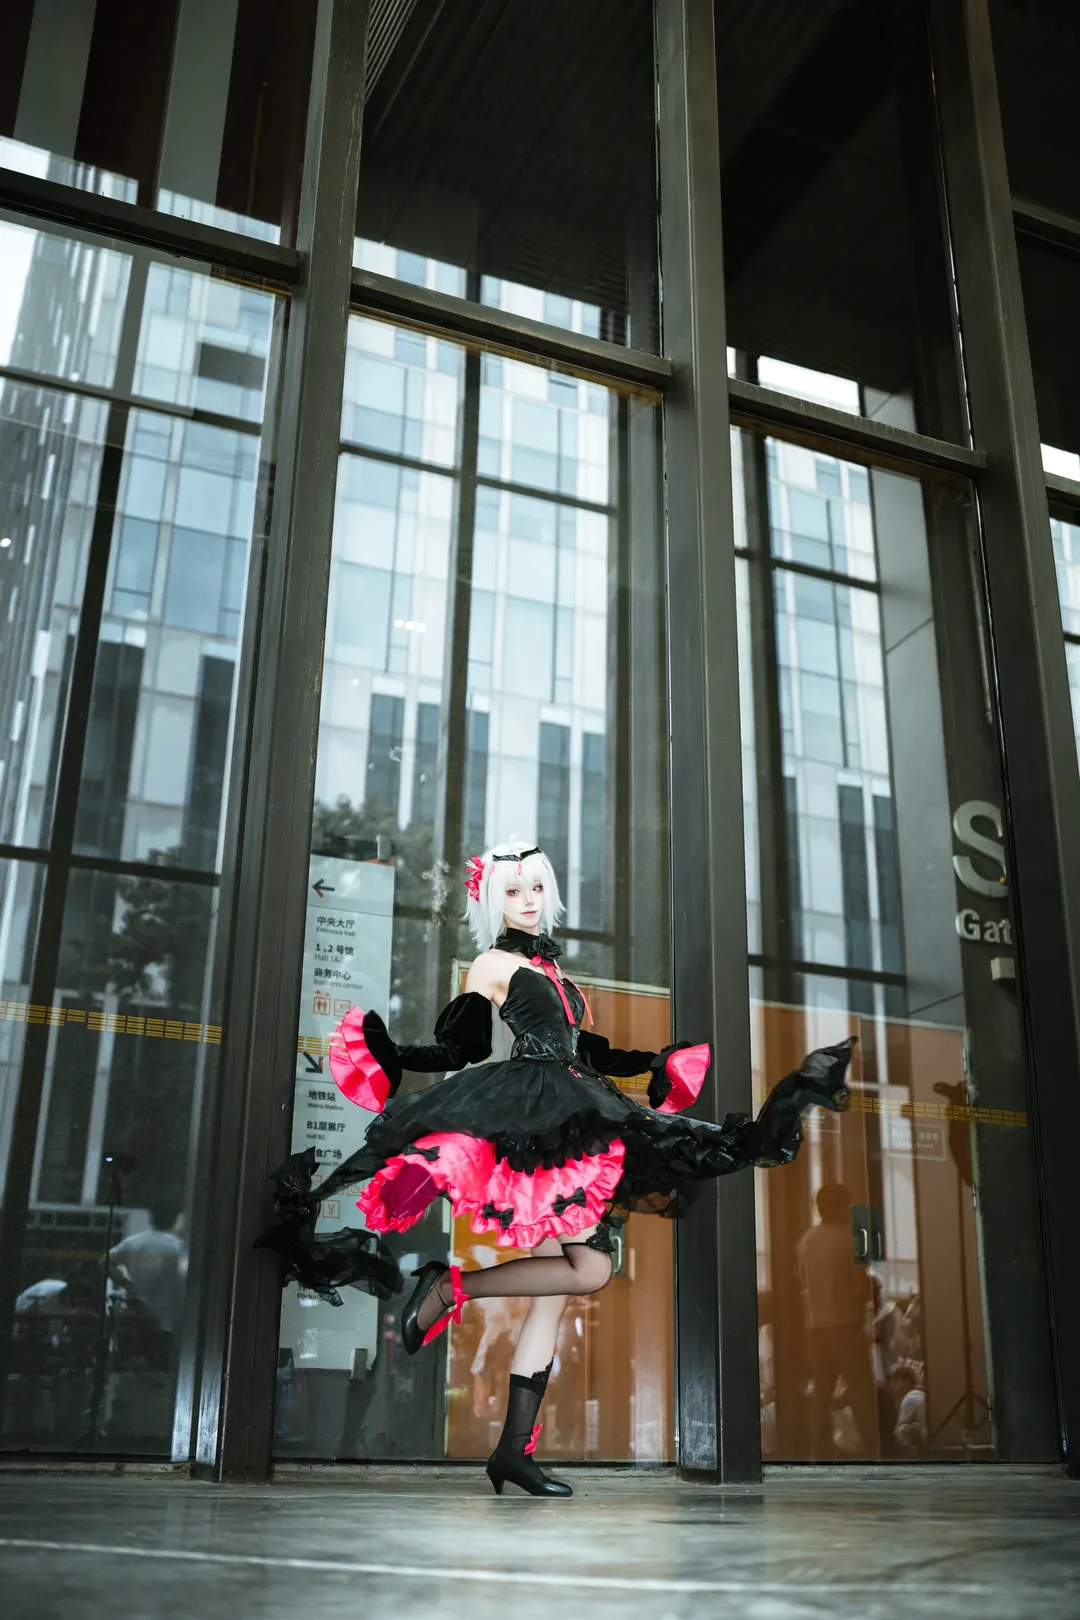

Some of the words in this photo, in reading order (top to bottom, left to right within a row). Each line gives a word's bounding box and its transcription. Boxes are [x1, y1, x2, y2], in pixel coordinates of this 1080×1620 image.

[317, 916, 355, 929] 中央大厅
[316, 927, 343, 935] Entrance
[314, 968, 351, 981] 商务中心
[308, 1090, 336, 1102] 地铁站
[307, 1121, 346, 1132] B1层展厅
[314, 1148, 342, 1159] 食广场
